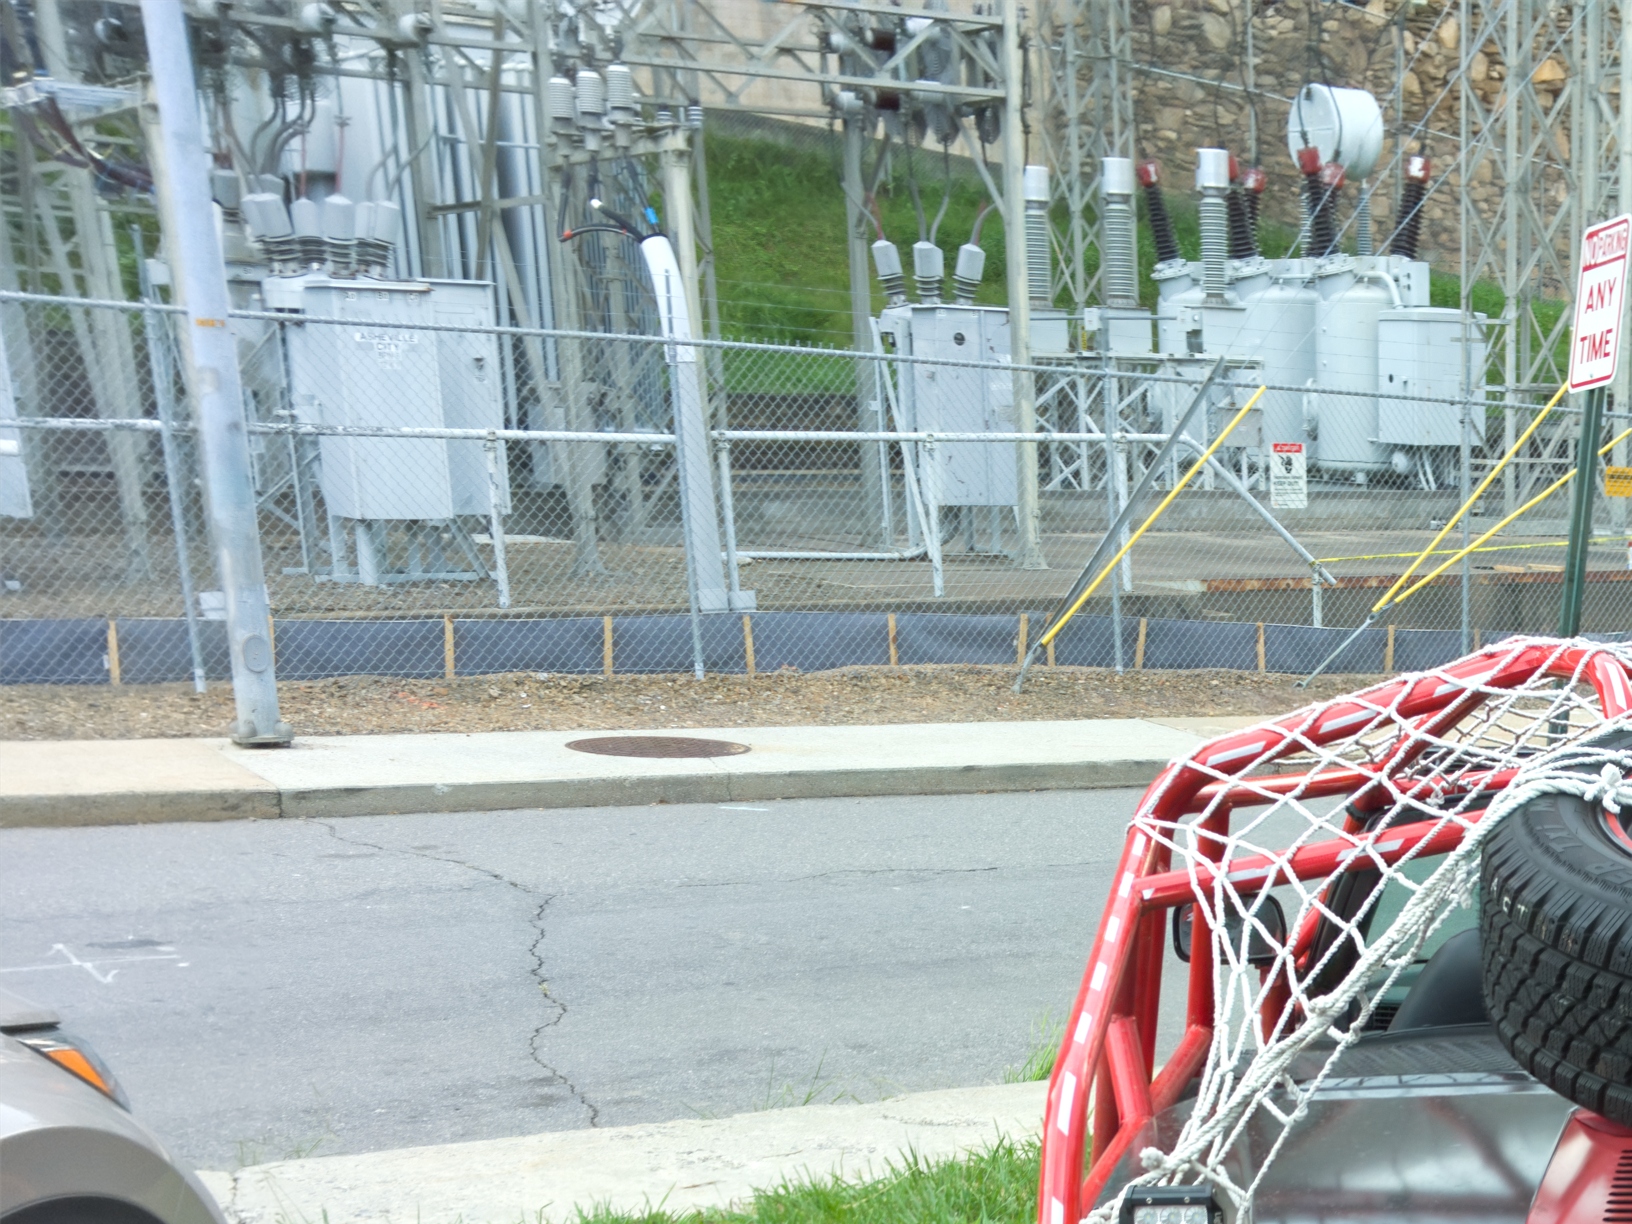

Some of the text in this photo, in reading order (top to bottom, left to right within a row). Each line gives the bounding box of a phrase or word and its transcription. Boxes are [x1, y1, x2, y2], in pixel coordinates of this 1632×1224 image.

[1582, 236, 1600, 267] NO
[1584, 276, 1617, 315] ANY
[1579, 327, 1614, 365] TIME
